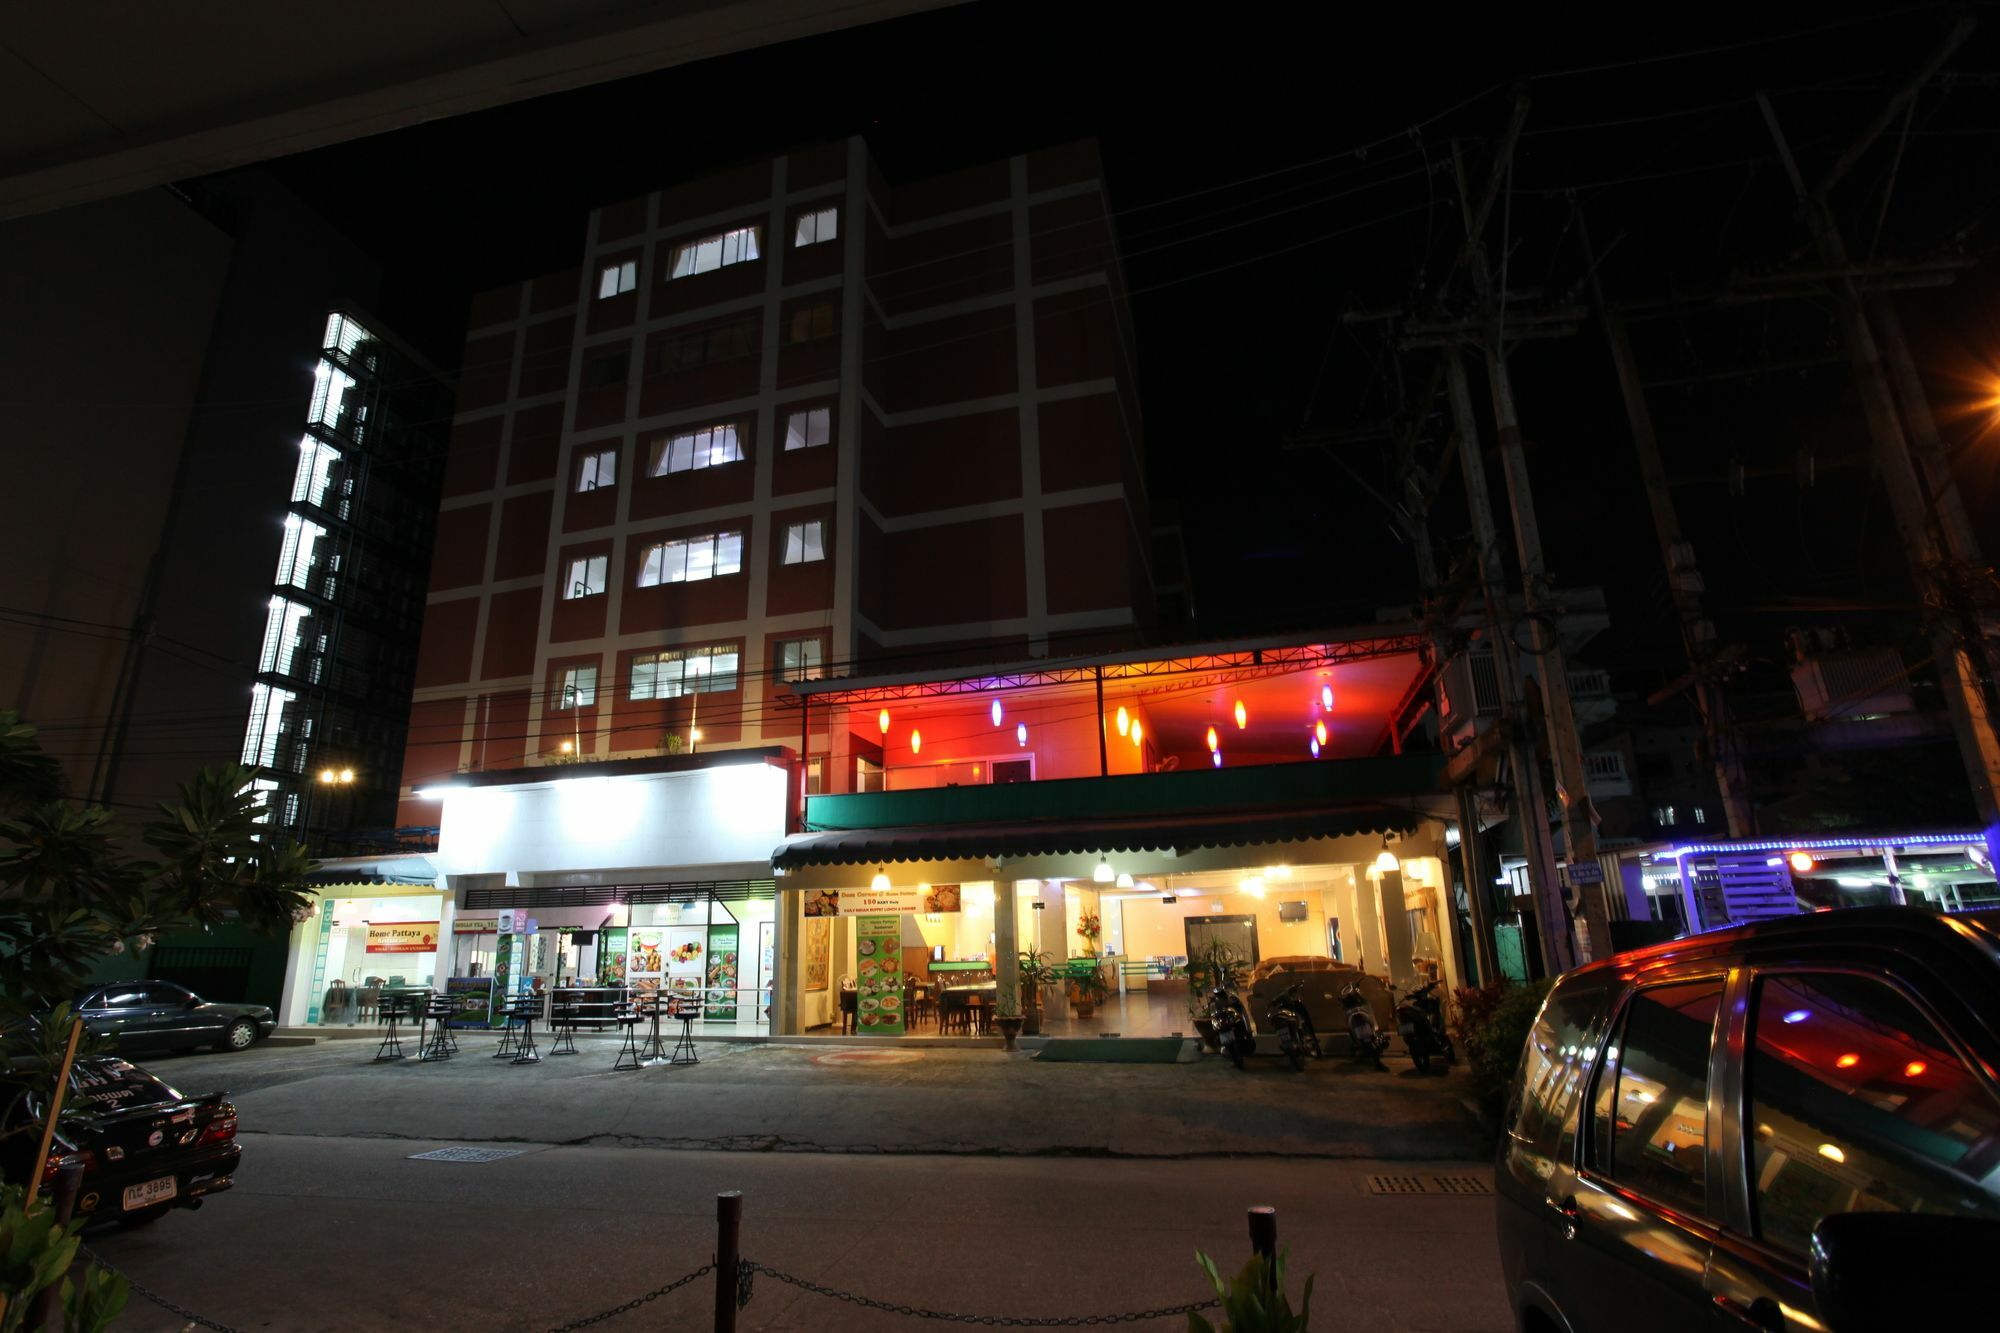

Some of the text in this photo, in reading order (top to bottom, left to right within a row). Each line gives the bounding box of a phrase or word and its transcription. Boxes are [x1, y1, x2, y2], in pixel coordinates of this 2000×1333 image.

[369, 929, 421, 938] Home Pattaya
[147, 1179, 171, 1195] 3895
